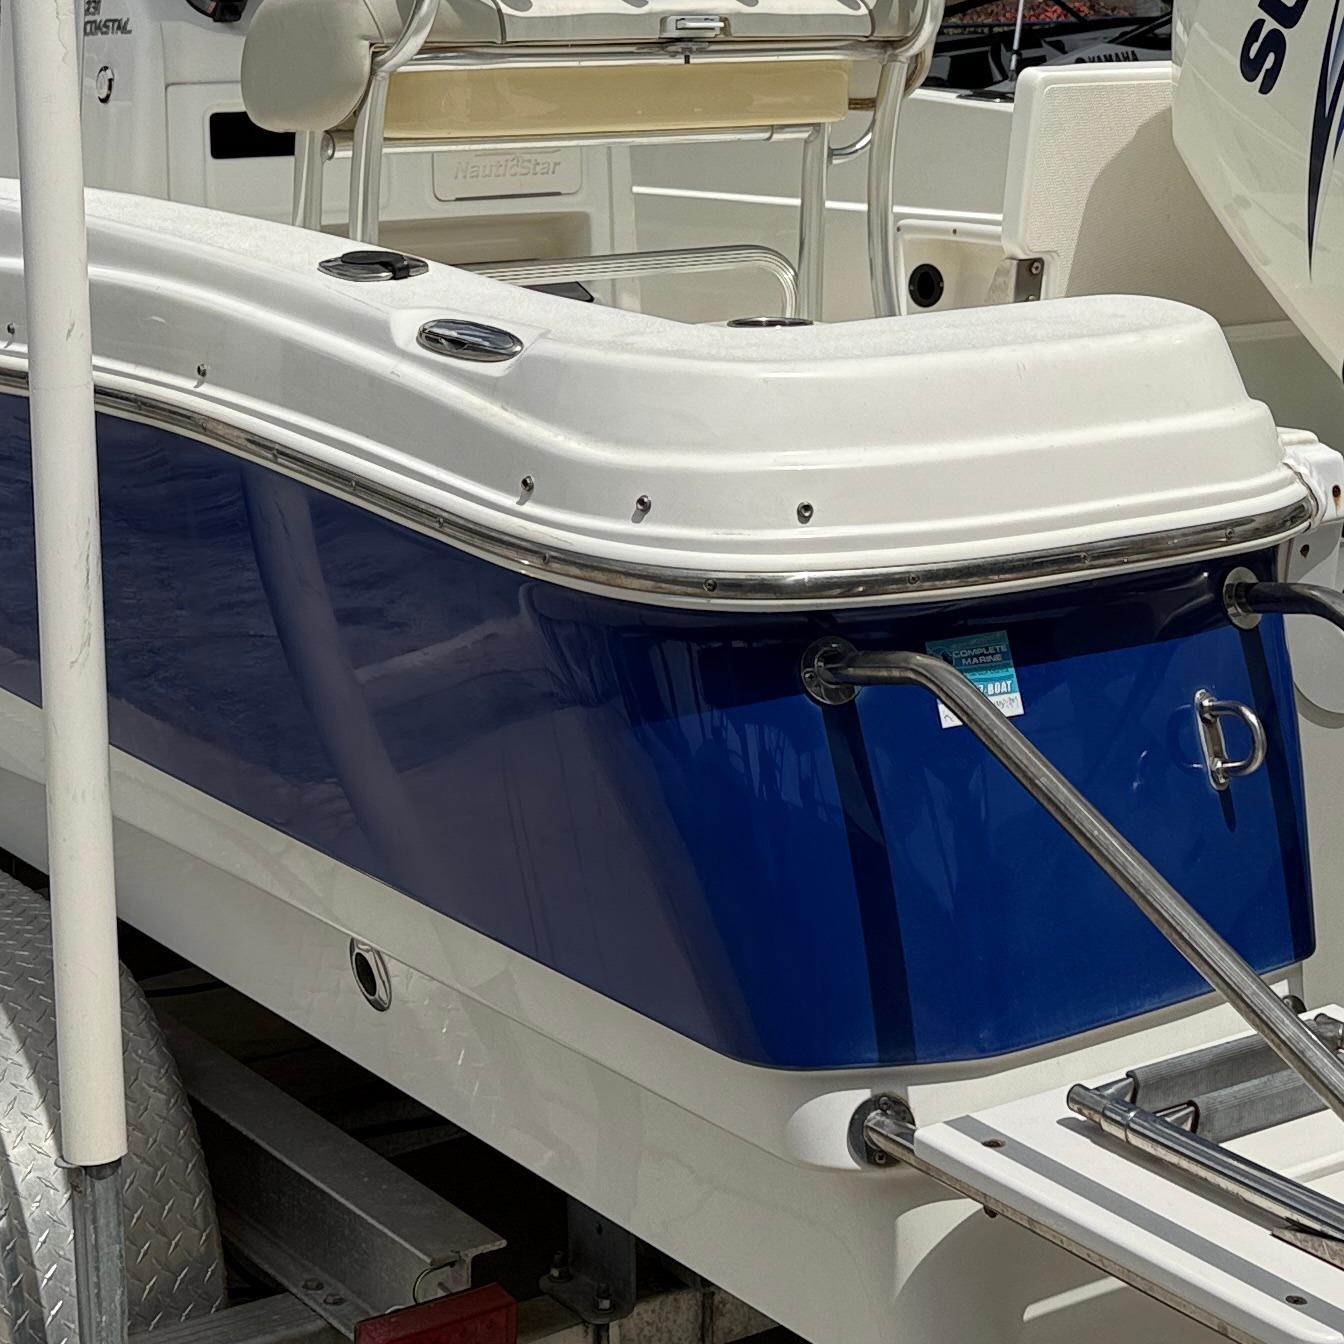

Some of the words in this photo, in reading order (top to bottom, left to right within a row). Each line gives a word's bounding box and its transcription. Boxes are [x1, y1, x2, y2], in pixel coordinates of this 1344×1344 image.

[83, 17, 133, 37] COASTAL
[1087, 49, 1140, 64] YAMAHA
[454, 156, 562, 180] NauticStar
[953, 643, 1008, 659] COMPLETE
[961, 653, 1003, 666] MARINE
